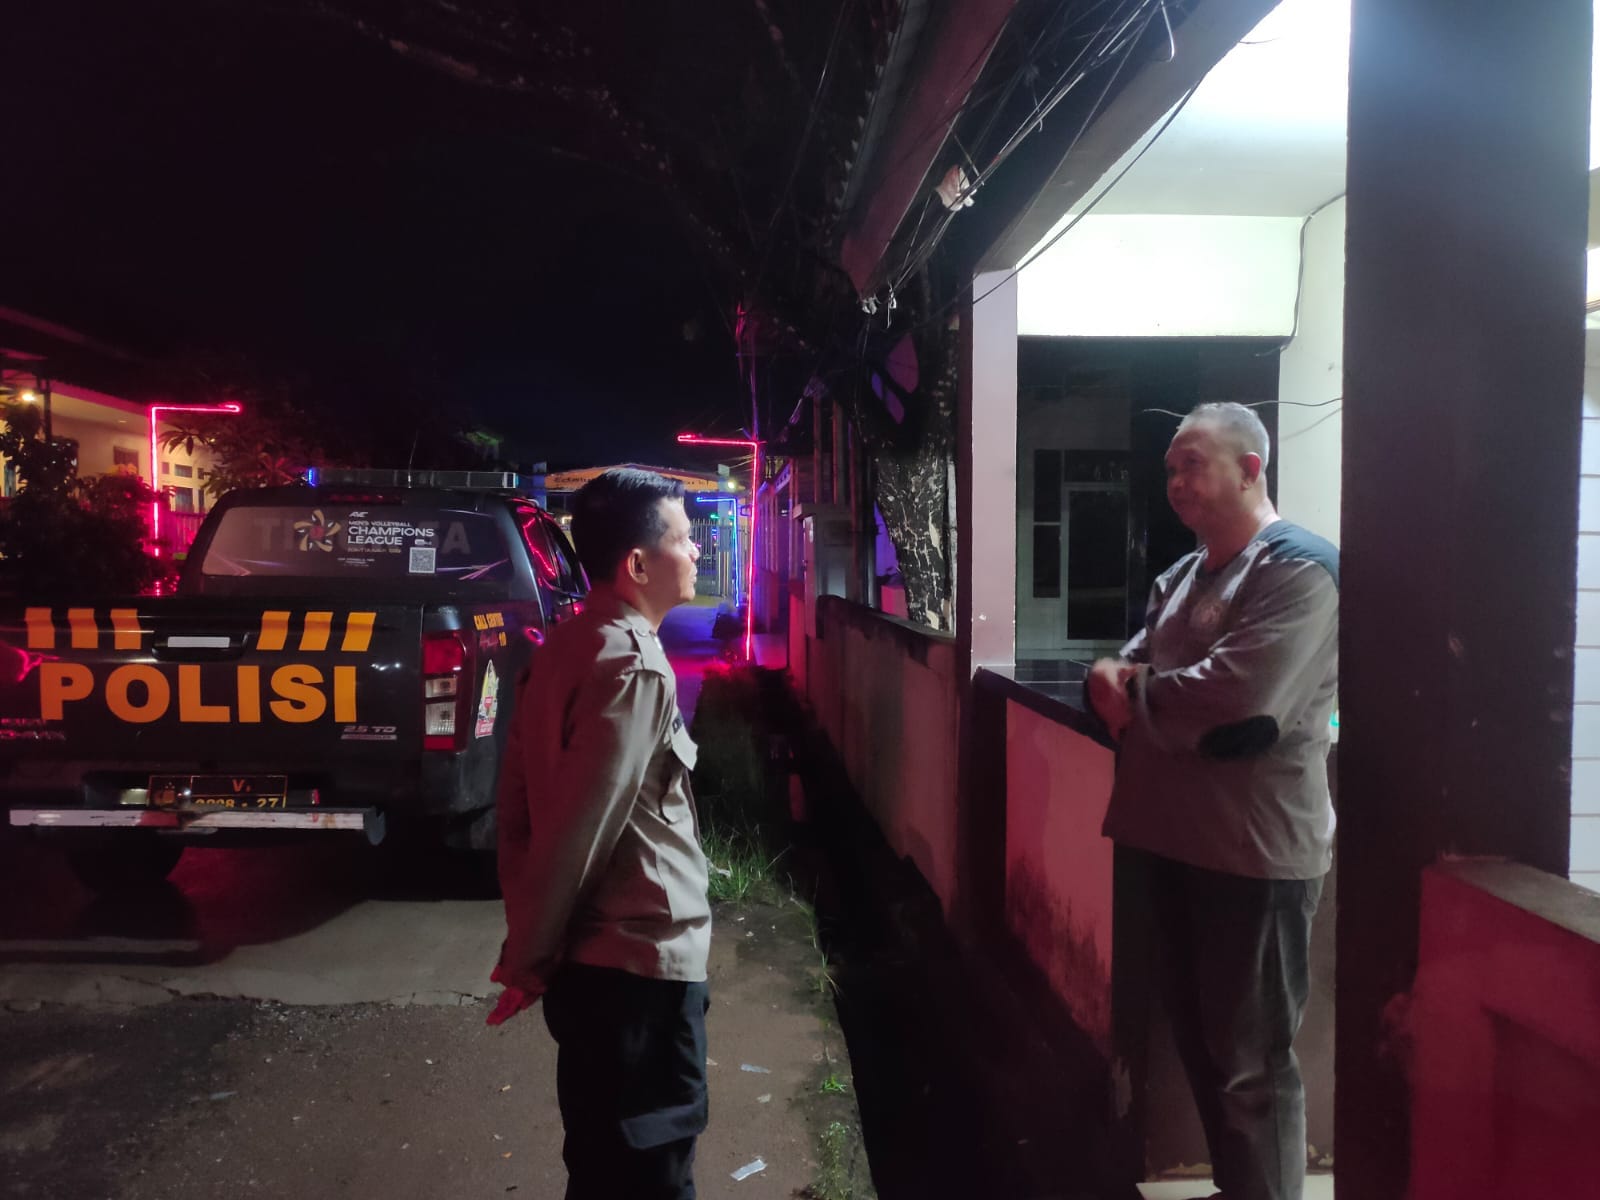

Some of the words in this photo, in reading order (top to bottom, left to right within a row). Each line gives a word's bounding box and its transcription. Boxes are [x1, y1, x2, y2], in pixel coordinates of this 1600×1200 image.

[348, 526, 435, 538] CHAMPIONS
[347, 535, 404, 546] LEAGUE
[39, 662, 357, 724] POLISI
